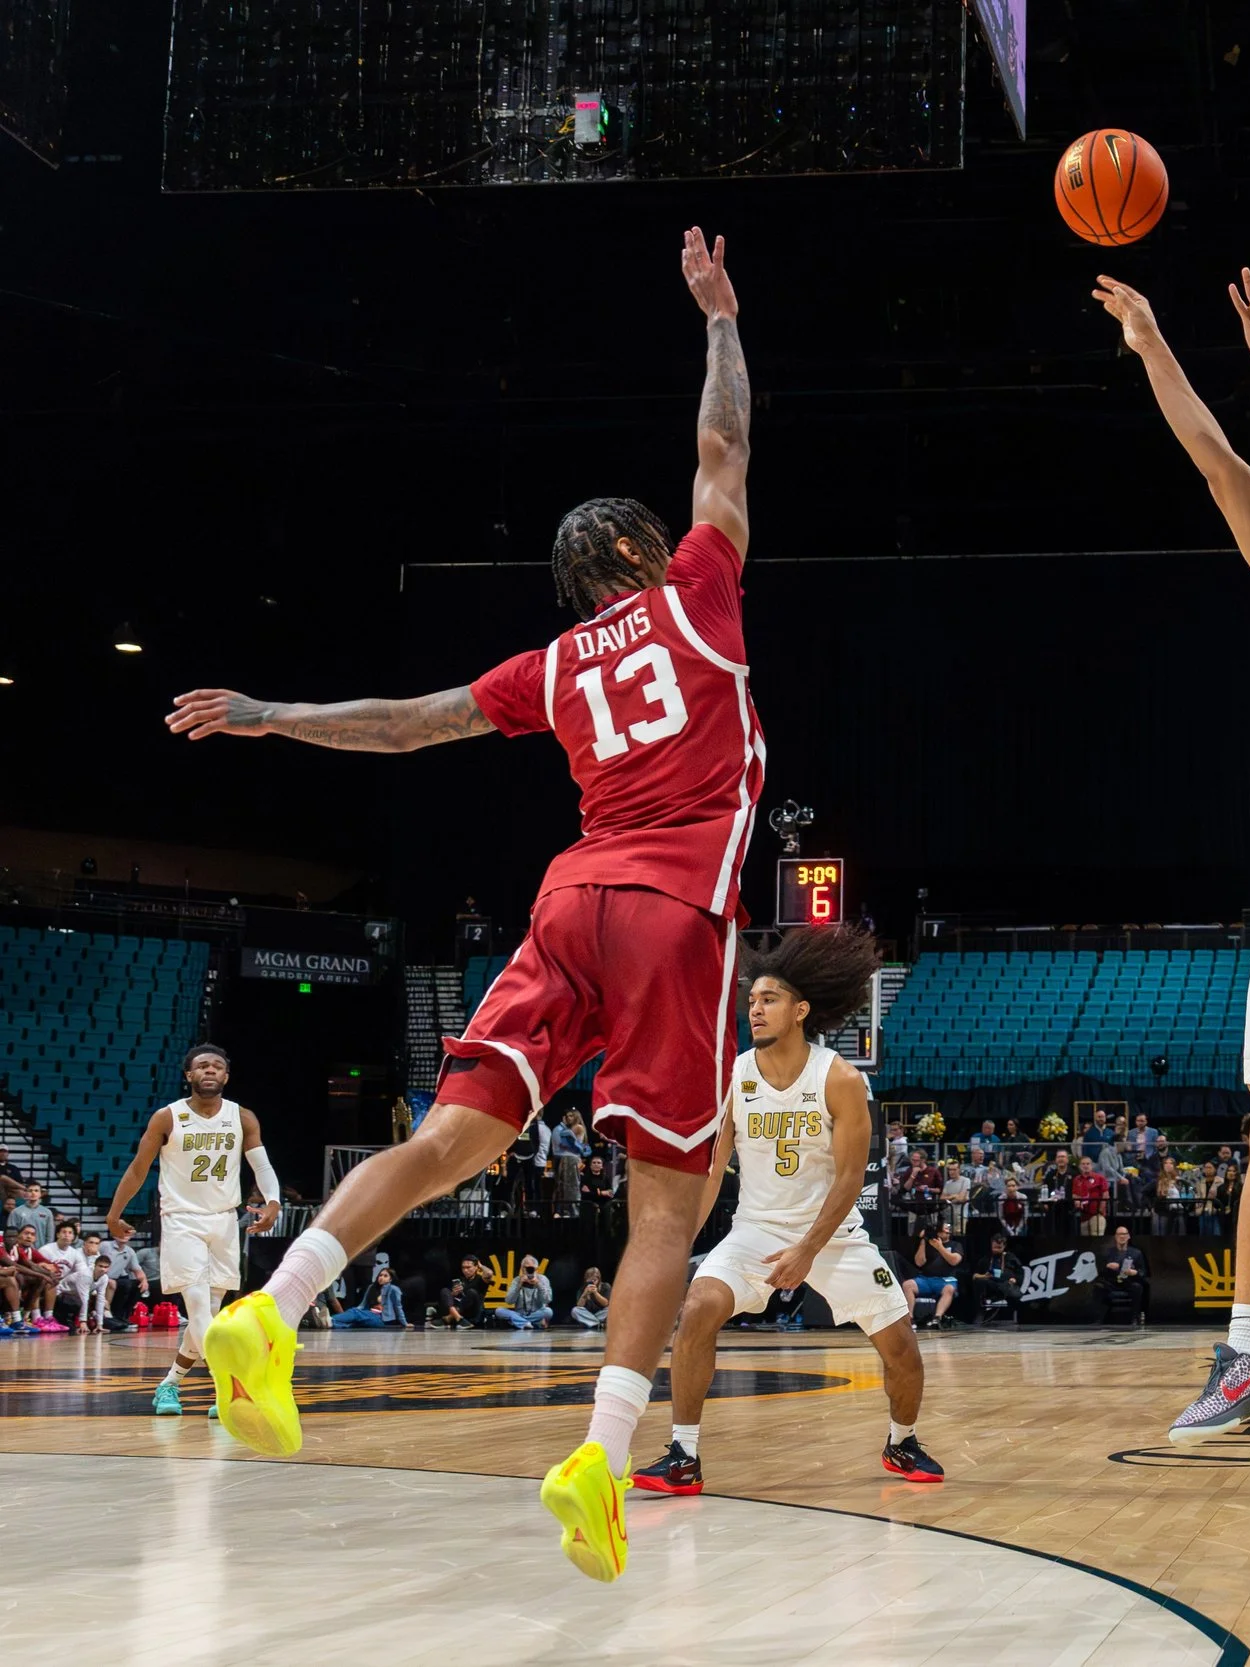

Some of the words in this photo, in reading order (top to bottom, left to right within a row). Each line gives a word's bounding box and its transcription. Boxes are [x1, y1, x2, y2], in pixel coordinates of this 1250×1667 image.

[574, 607, 652, 660] DAVIS
[576, 643, 689, 762] 13
[798, 866, 836, 885] 3:09
[812, 886, 830, 917] 6
[372, 927, 381, 939] 4
[474, 928, 482, 940] 2
[254, 951, 300, 968] MGM
[305, 955, 370, 972] GRAND
[261, 970, 311, 980] GARDEN
[318, 974, 360, 983] ARENA
[748, 1111, 821, 1139] BUFFS
[182, 1132, 236, 1151] BUFFS
[190, 1154, 228, 1182] 24
[775, 1139, 800, 1176] 5
